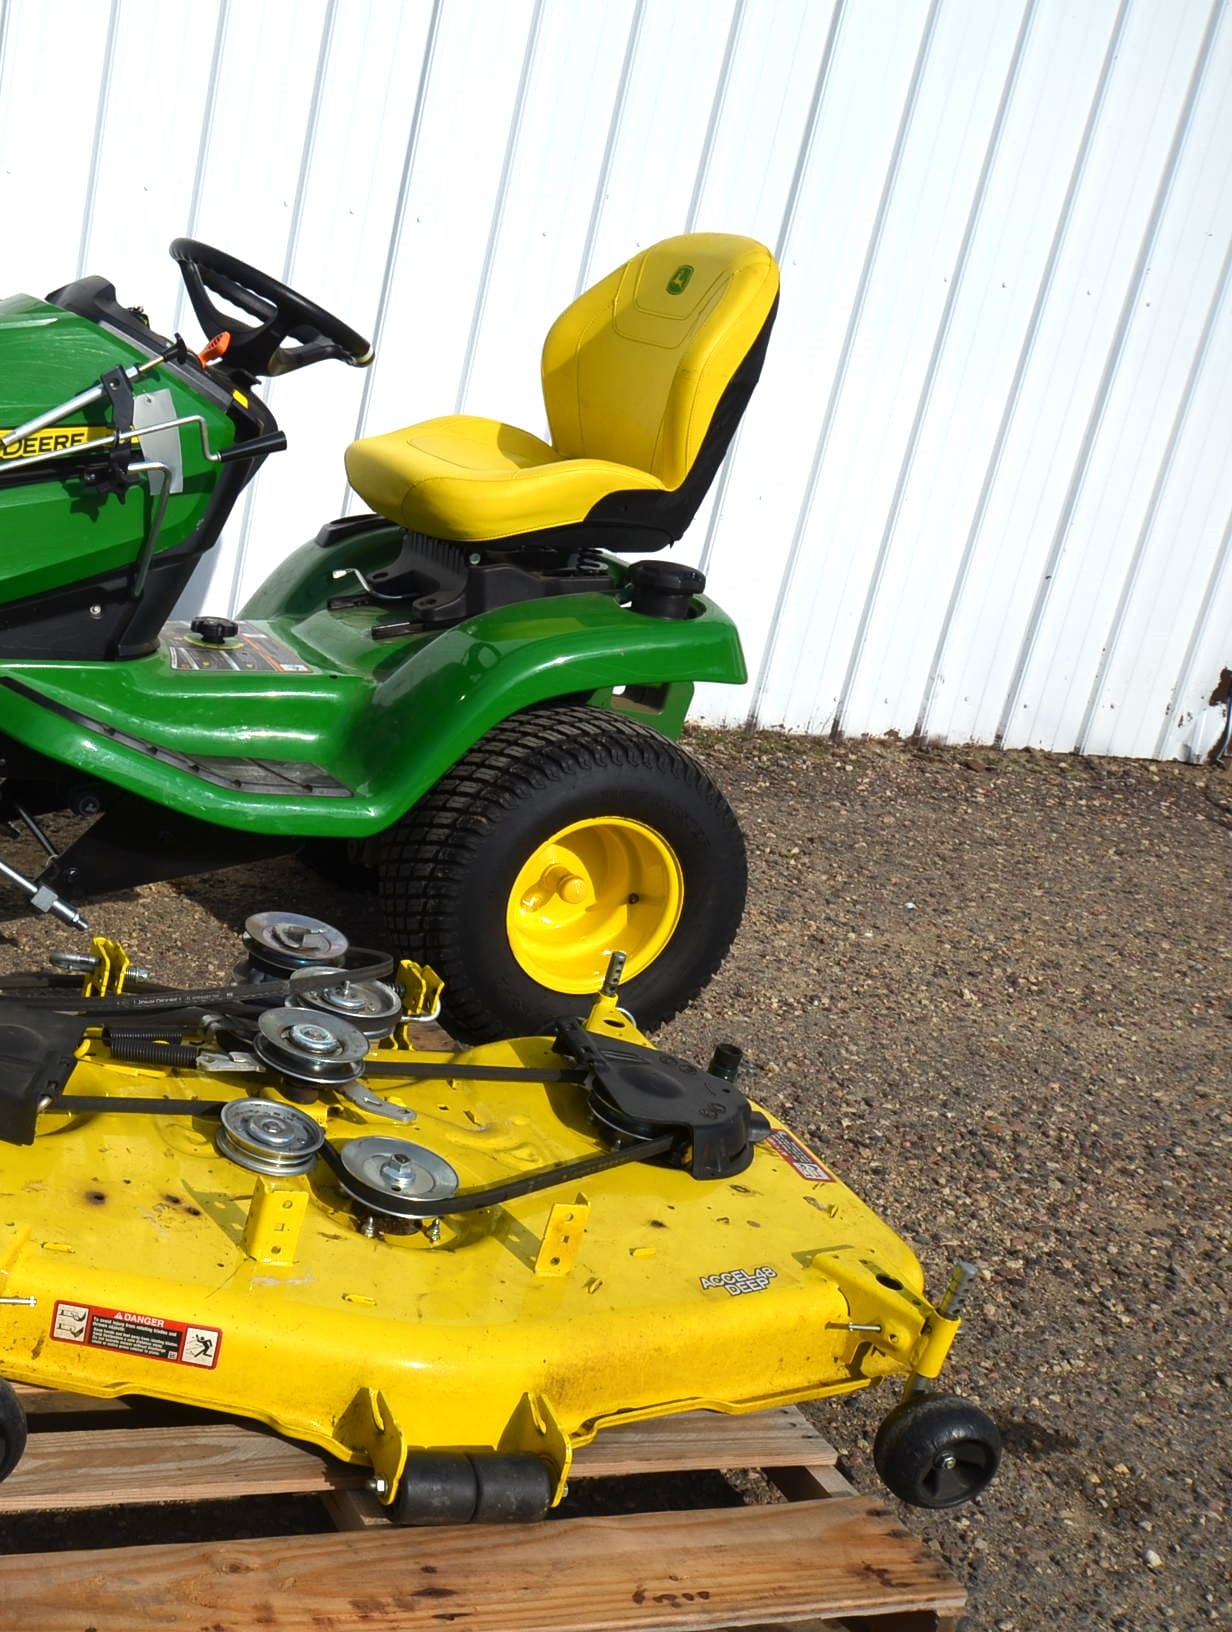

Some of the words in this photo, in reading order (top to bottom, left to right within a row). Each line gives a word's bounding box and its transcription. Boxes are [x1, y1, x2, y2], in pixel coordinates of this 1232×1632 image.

[2, 432, 85, 456] DEERE
[700, 1268, 757, 1290] ACCEL
[724, 1278, 770, 1296] DEEP
[124, 1312, 165, 1328] DANGER
